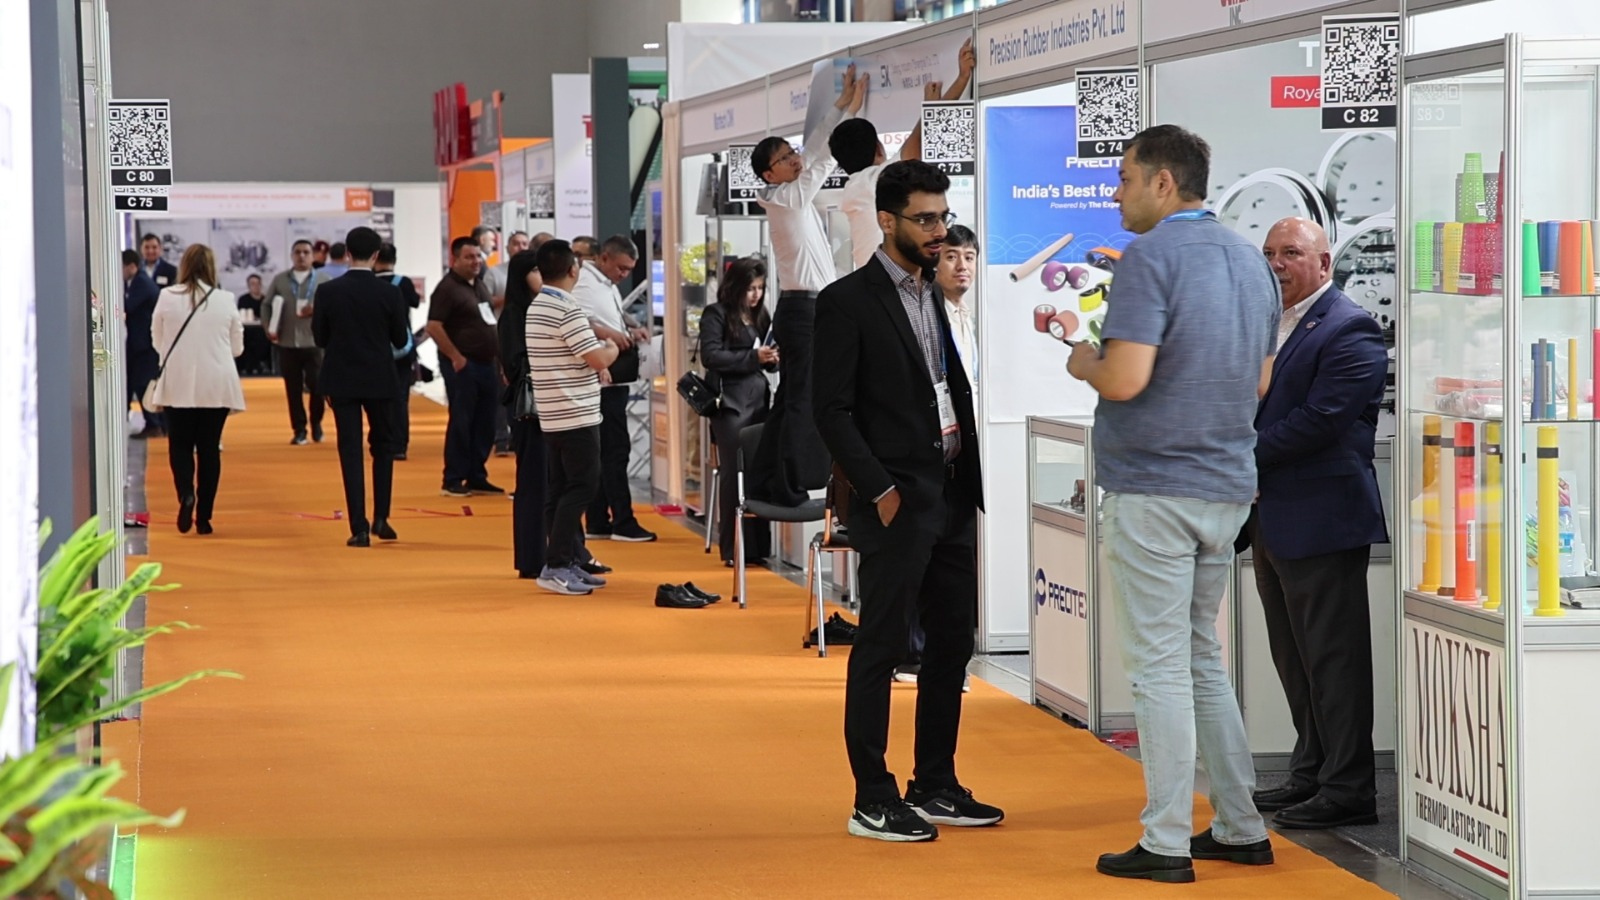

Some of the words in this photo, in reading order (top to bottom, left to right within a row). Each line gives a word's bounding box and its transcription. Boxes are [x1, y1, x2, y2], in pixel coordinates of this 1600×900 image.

[990, 33, 1021, 66] Precision
[1023, 25, 1049, 57] Rubber
[1051, 12, 1090, 51] Industries
[1092, 7, 1108, 40] Pvt.
[1110, 0, 1125, 36] Ltd
[1283, 85, 1321, 102] Roya
[1343, 109, 1356, 123] C
[1359, 108, 1379, 122] 82
[1095, 142, 1105, 153] C
[1107, 142, 1123, 153] 74
[1066, 156, 1121, 168] PRECIT
[948, 163, 962, 173] 73
[126, 171, 136, 182] C
[139, 171, 155, 182] 80
[824, 179, 830, 187] C
[831, 178, 841, 186] 72
[740, 189, 749, 198] C
[1012, 184, 1060, 199] India's
[1063, 184, 1096, 198] Best
[127, 197, 137, 207] C
[139, 197, 153, 208] 75
[1079, 201, 1087, 209] by
[1413, 627, 1508, 818] MOKSHA
[1415, 791, 1476, 845] THERMOPLASTICS
[1478, 820, 1493, 853] PVT.
[1495, 828, 1508, 860] LTD
